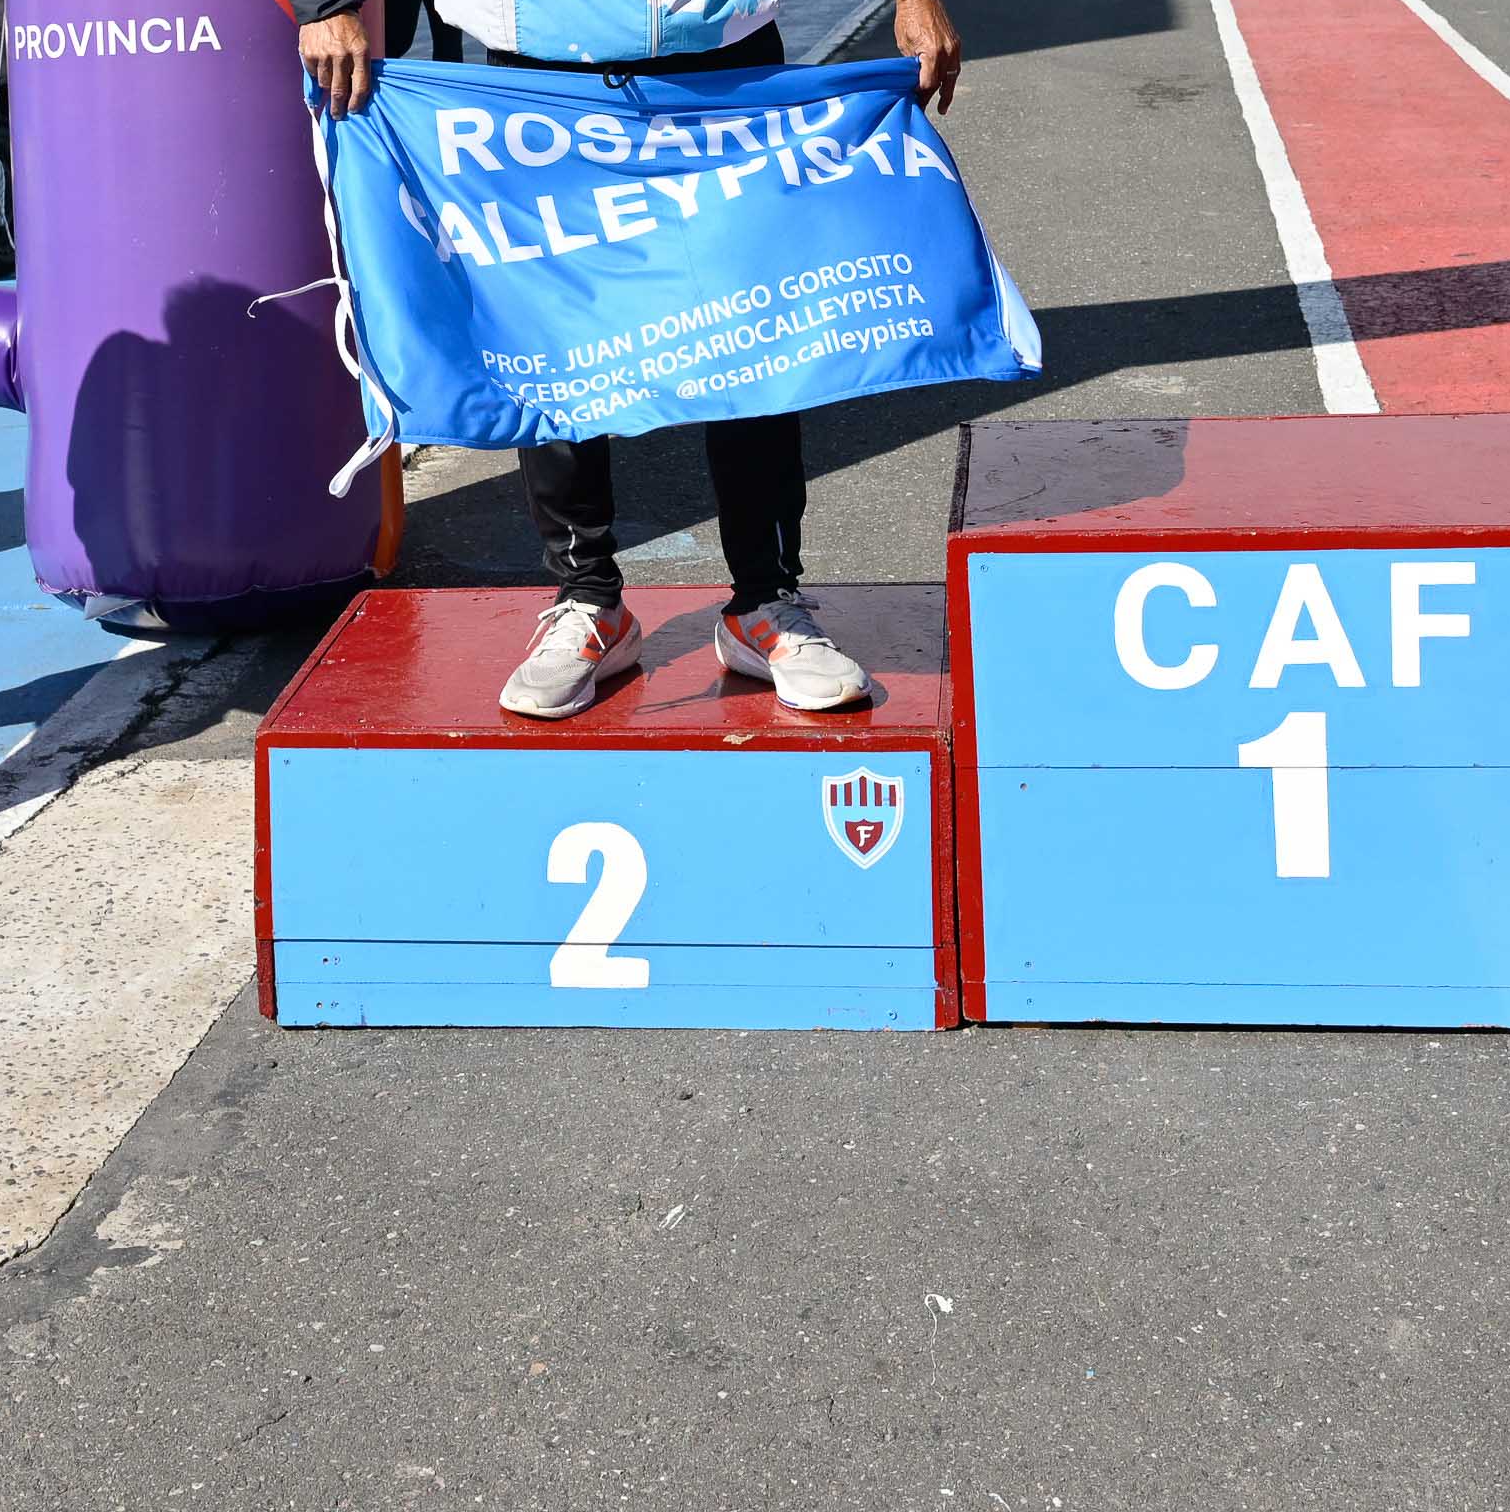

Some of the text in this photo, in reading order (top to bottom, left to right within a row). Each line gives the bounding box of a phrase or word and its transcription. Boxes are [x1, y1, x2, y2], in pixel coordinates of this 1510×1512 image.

[13, 15, 222, 61] PROVINCIA
[435, 96, 845, 176] ROSARIO
[481, 253, 914, 375] PROF. JUAN DOMINGO GOROSITO
[639, 284, 926, 383] ROSARIOCALLEYPISTA
[675, 316, 935, 400] @rosario.calleypista
[1112, 560, 1478, 691] CAF
[1237, 711, 1331, 879] 1
[545, 821, 651, 990] 2
